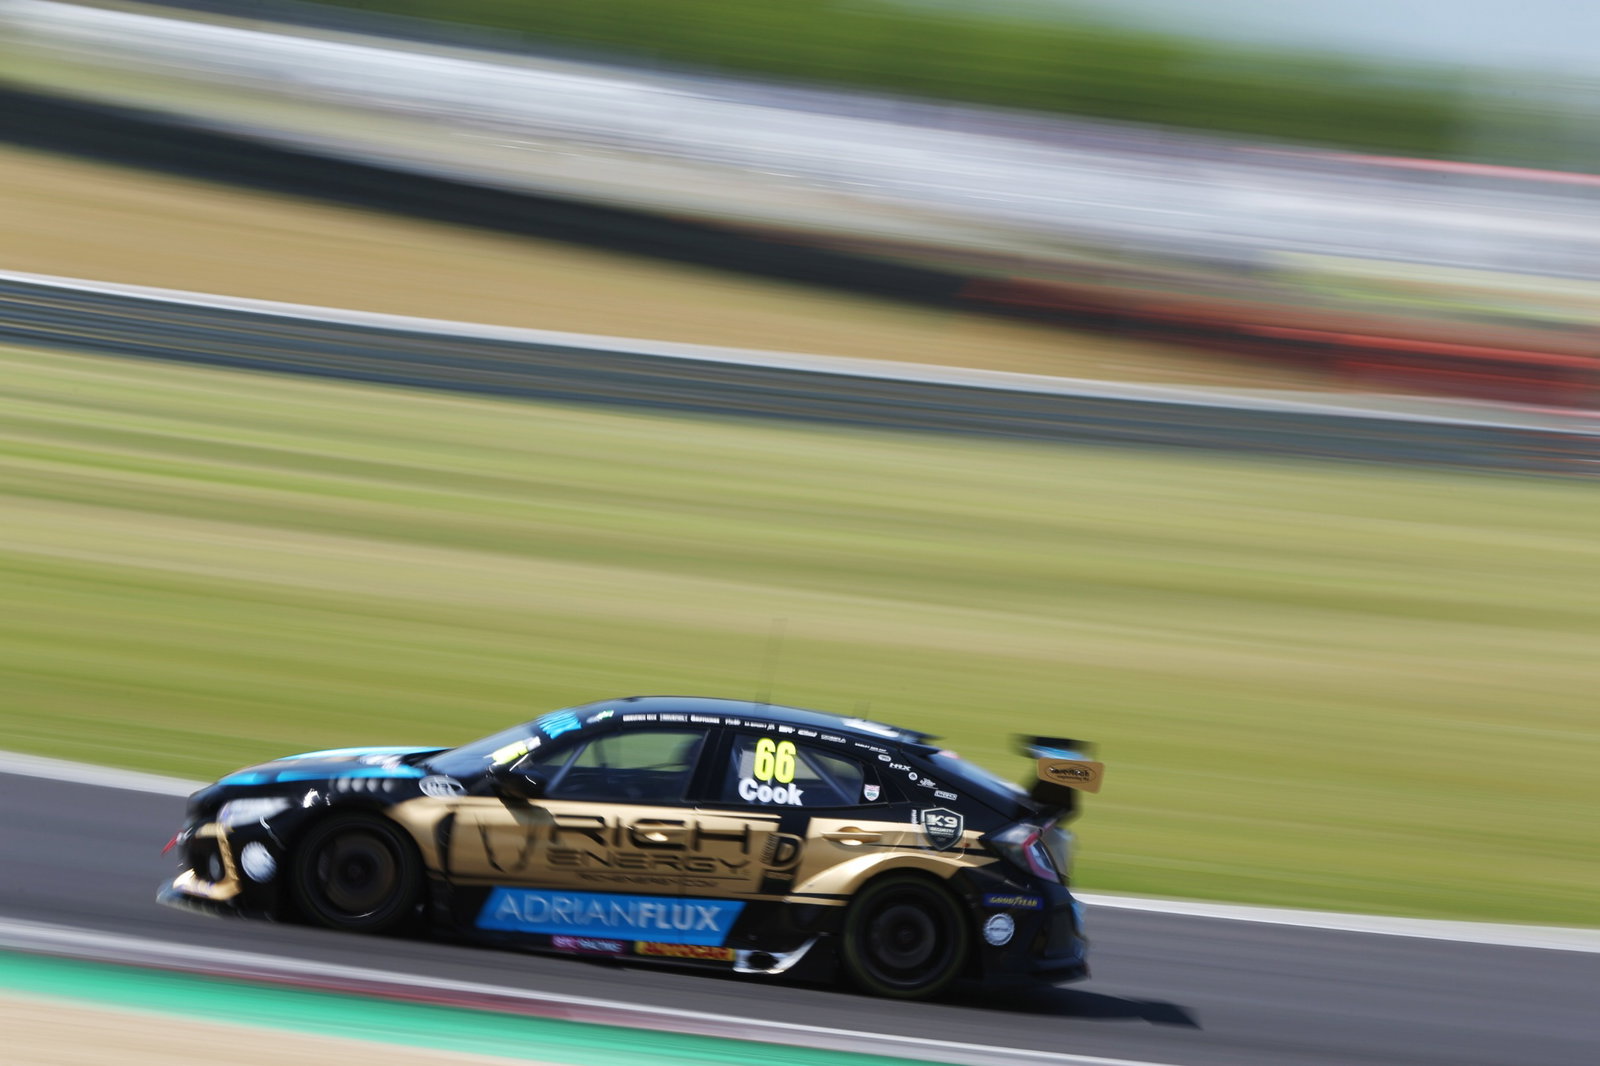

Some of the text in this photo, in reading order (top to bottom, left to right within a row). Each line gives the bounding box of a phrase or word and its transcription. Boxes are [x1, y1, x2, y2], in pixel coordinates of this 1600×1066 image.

[754, 738, 796, 783] 66
[738, 778, 804, 806] Cook
[549, 813, 750, 855] RICH
[926, 814, 958, 828] K9
[547, 848, 750, 875] ENERGY
